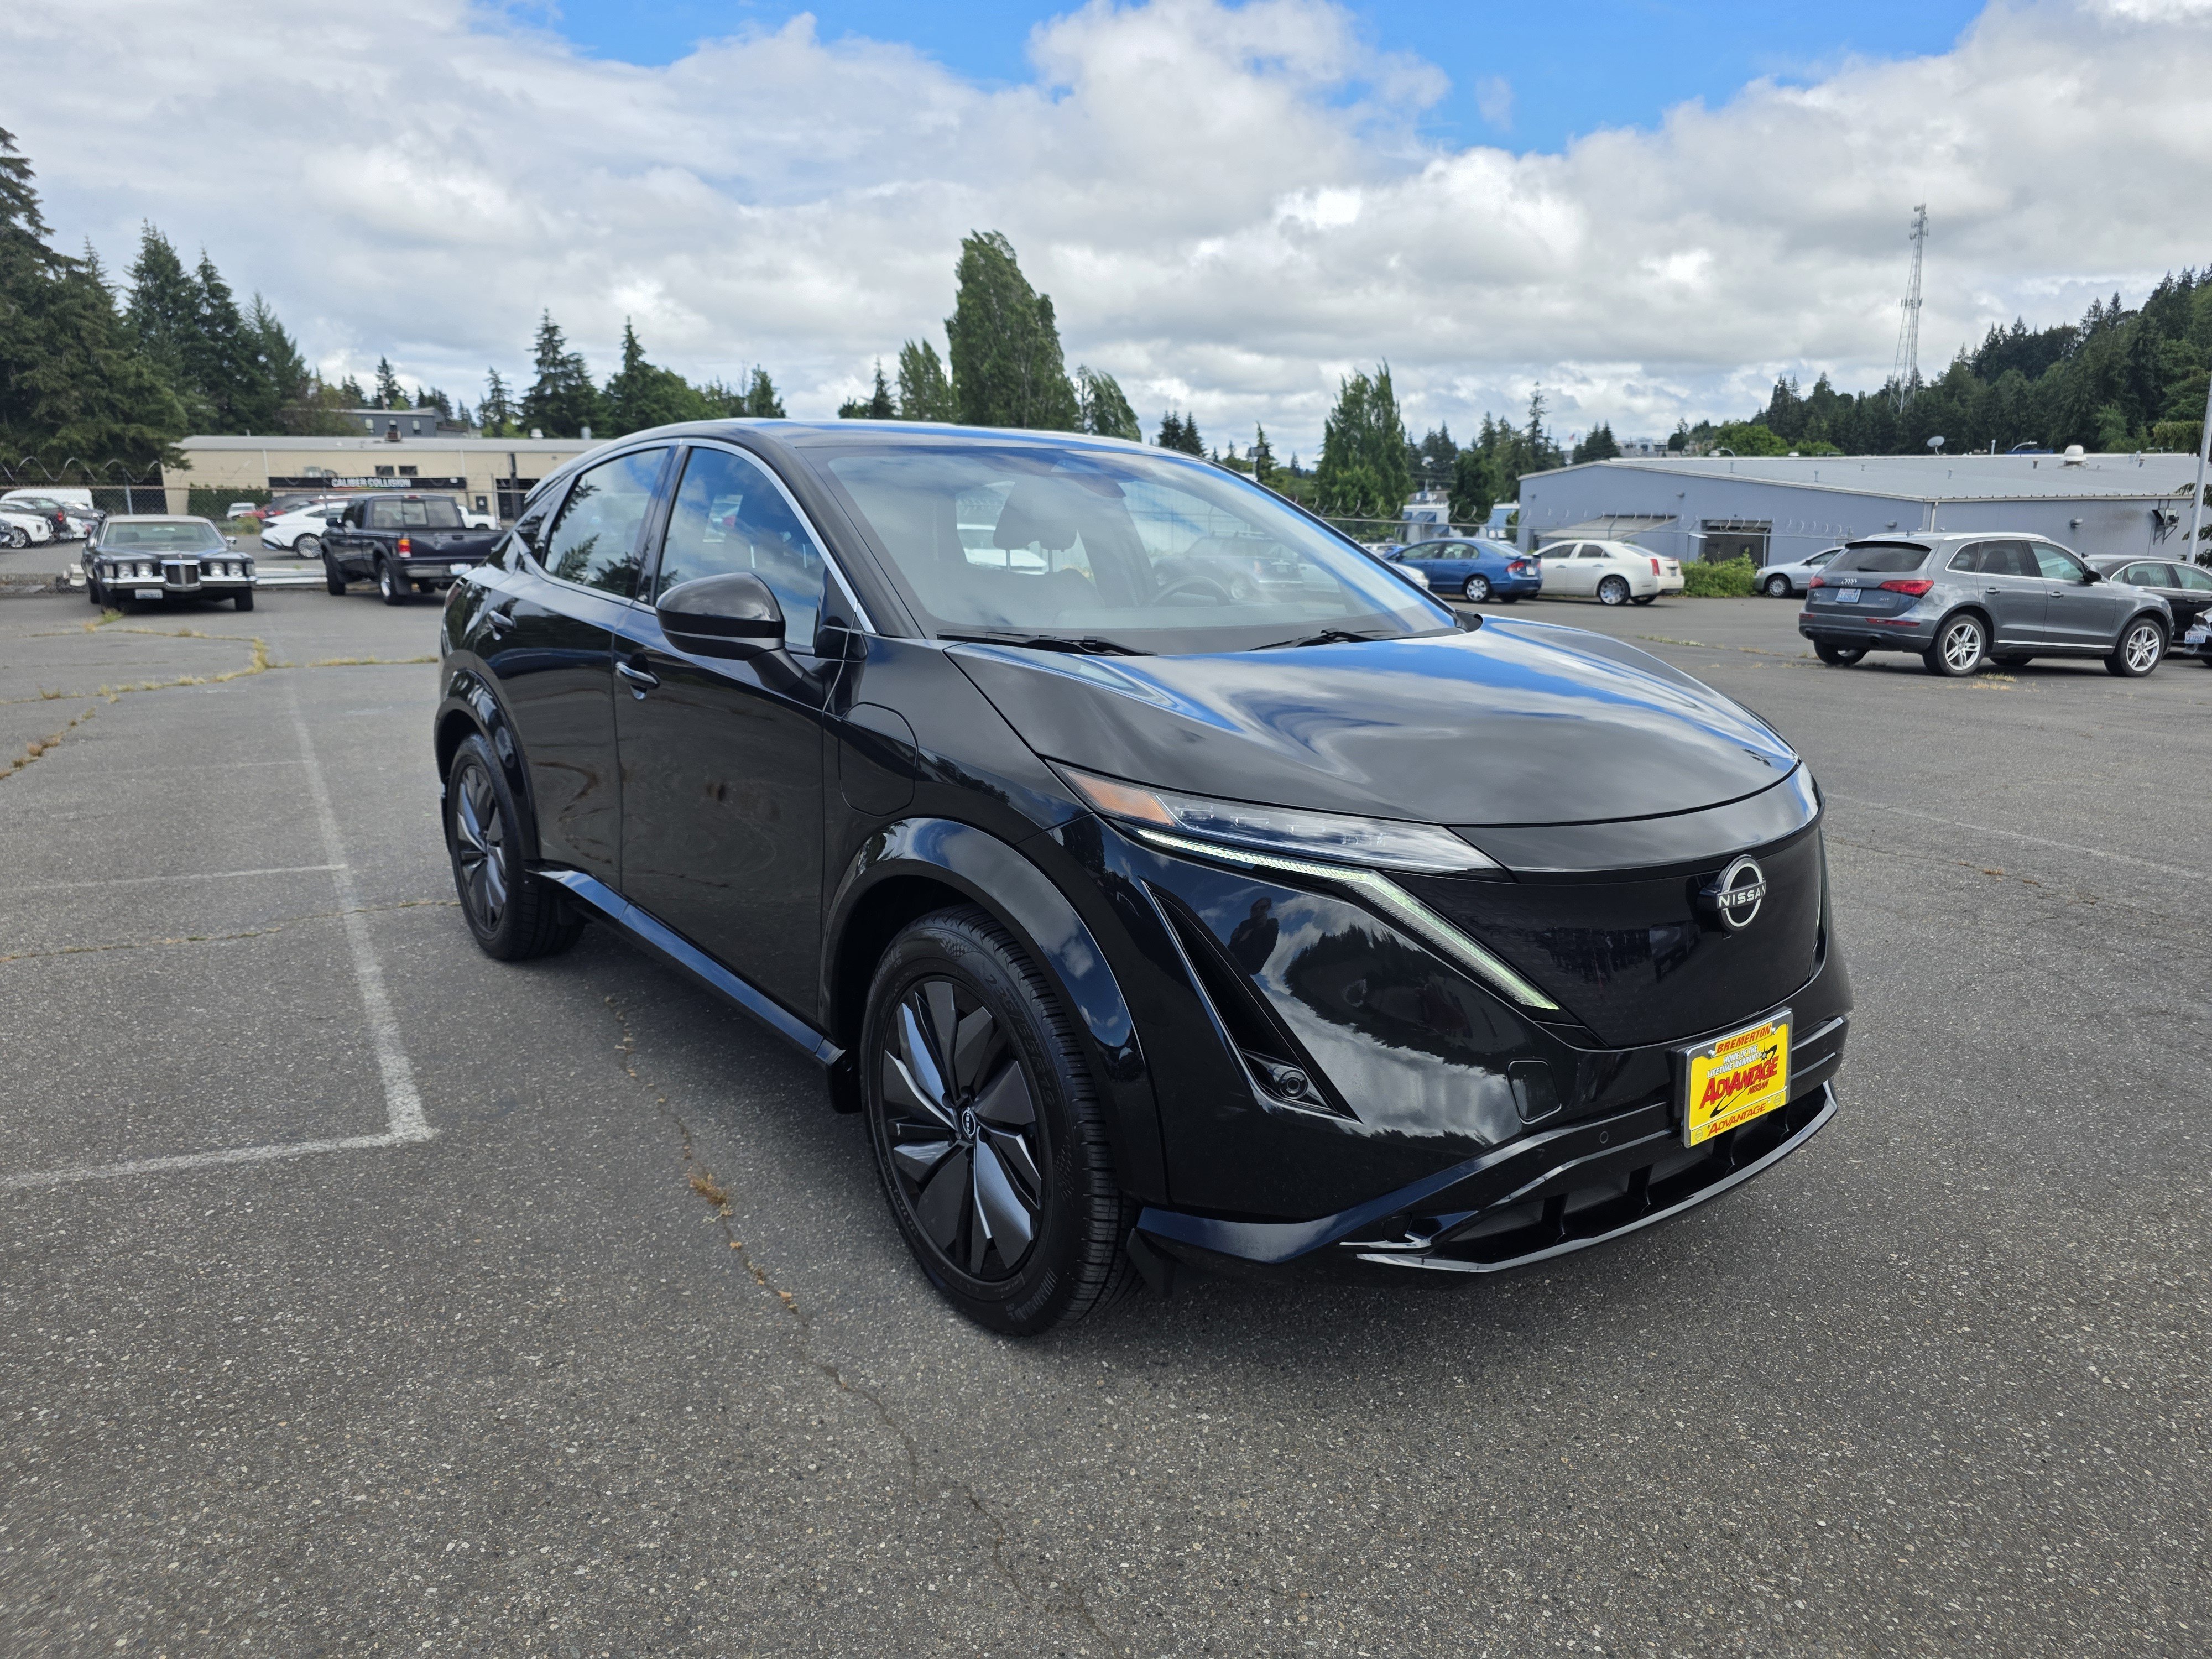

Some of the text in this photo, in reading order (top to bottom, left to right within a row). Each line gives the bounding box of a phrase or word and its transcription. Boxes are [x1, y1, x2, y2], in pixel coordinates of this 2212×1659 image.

[1719, 884, 1766, 907] NISSAN
[1717, 1025, 1771, 1054] BREMERTON
[1707, 1051, 1762, 1078] LIFETIME WARRANTY
[1723, 1052, 1739, 1064] HOME
[1748, 1044, 1759, 1052] THE
[1699, 1055, 1779, 1110] ADVANTAGE
[1747, 1079, 1769, 1095] NISSAN
[1707, 1102, 1767, 1137] ADVANTAGE
